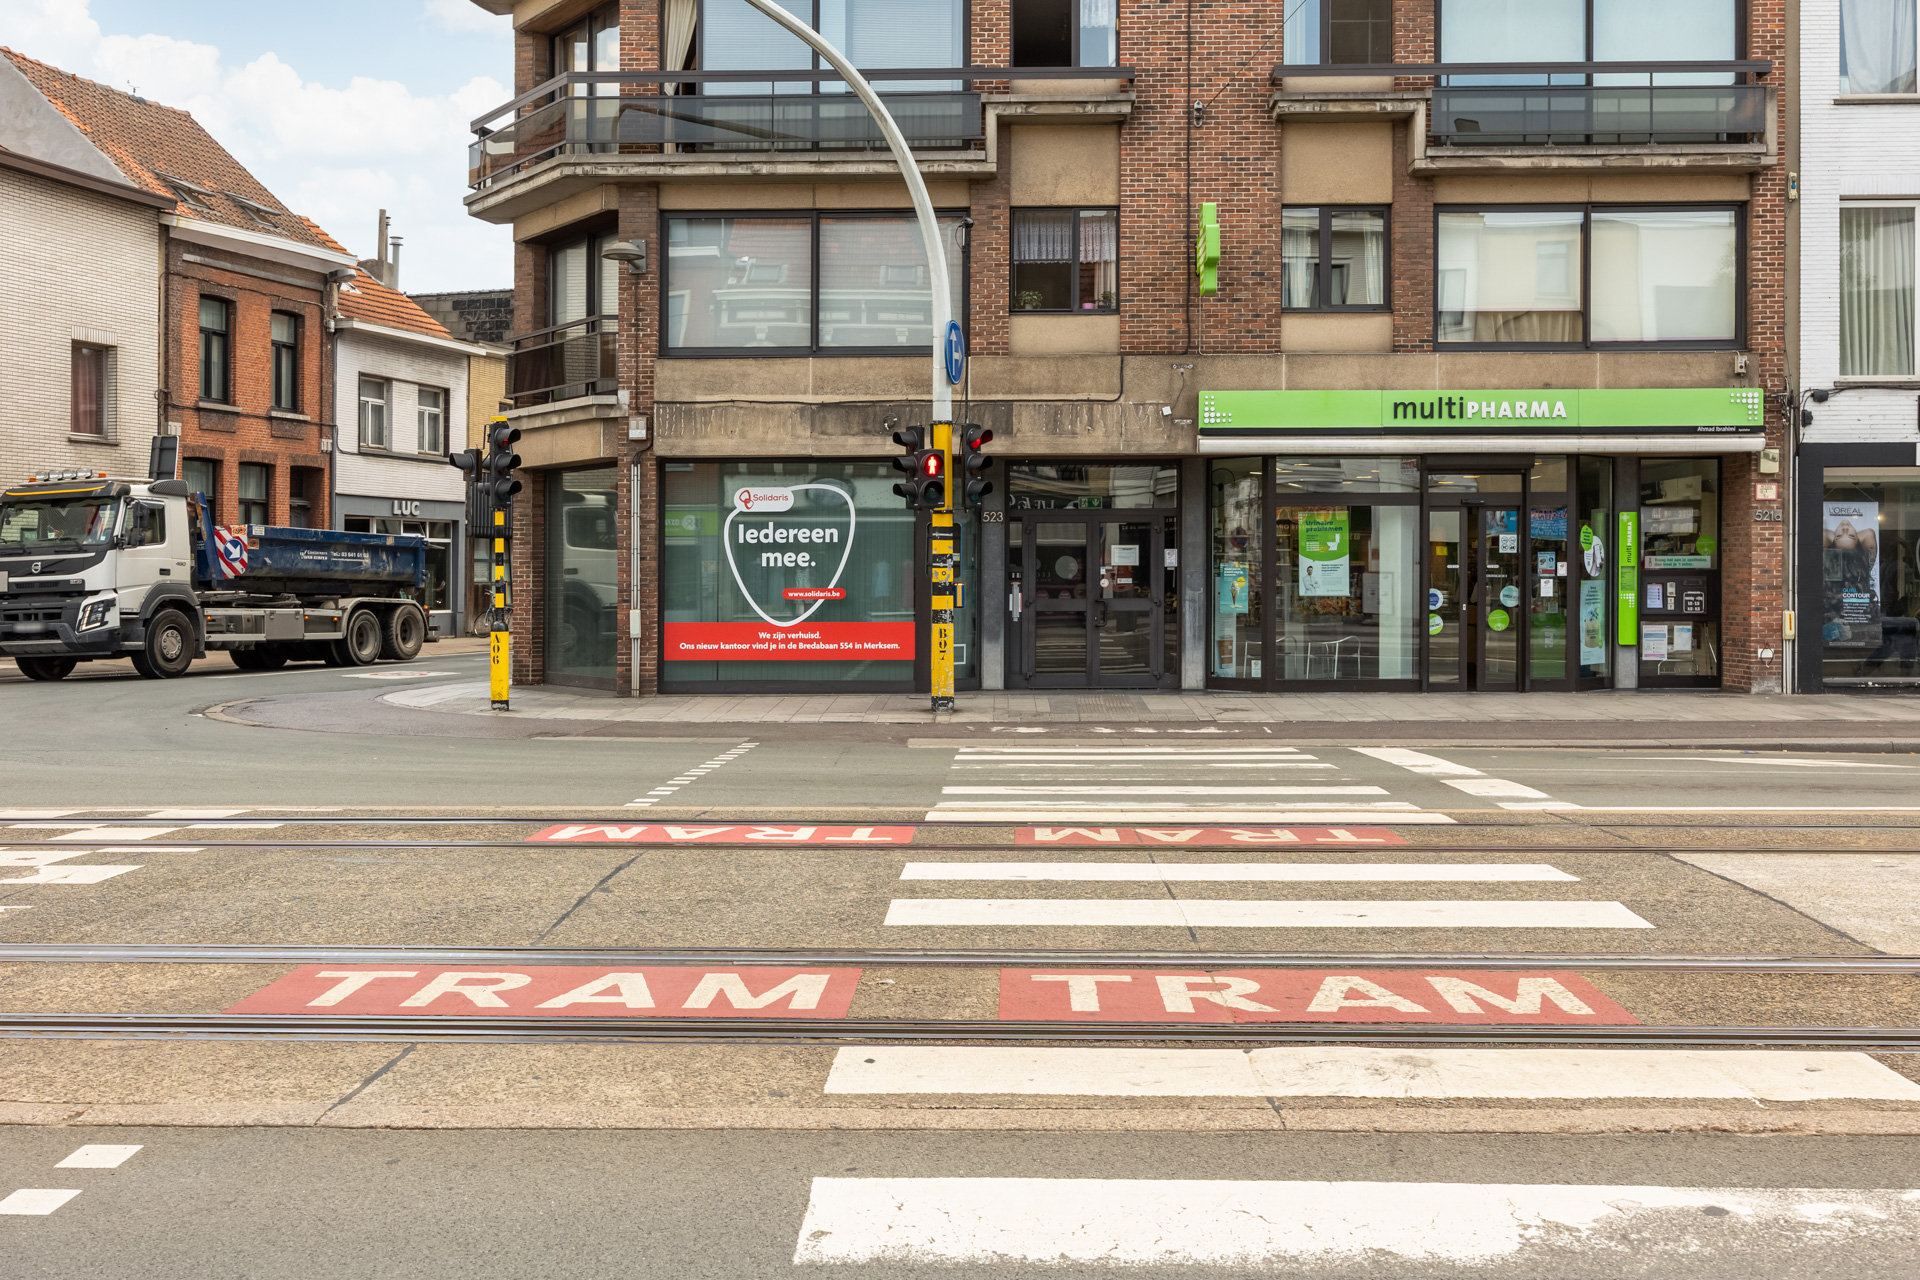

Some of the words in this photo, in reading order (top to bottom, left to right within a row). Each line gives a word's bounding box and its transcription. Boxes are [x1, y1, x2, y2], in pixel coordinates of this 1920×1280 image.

[1393, 396, 1567, 419] multiPHARMA
[752, 494, 789, 502] Solidaris
[392, 500, 420, 516] LUC
[982, 511, 1004, 523] 523
[738, 522, 839, 544] Iedereen
[761, 552, 816, 567] mee.
[788, 590, 840, 598] www.solidaris.be
[772, 632, 786, 640] zijn
[696, 642, 719, 650] nieuw
[752, 642, 768, 650] vind
[770, 642, 777, 651] je
[547, 826, 892, 841] TRAM
[1034, 828, 1386, 842] TRAM
[305, 970, 831, 1010] TRAM
[1030, 974, 1597, 1016] TRAM
